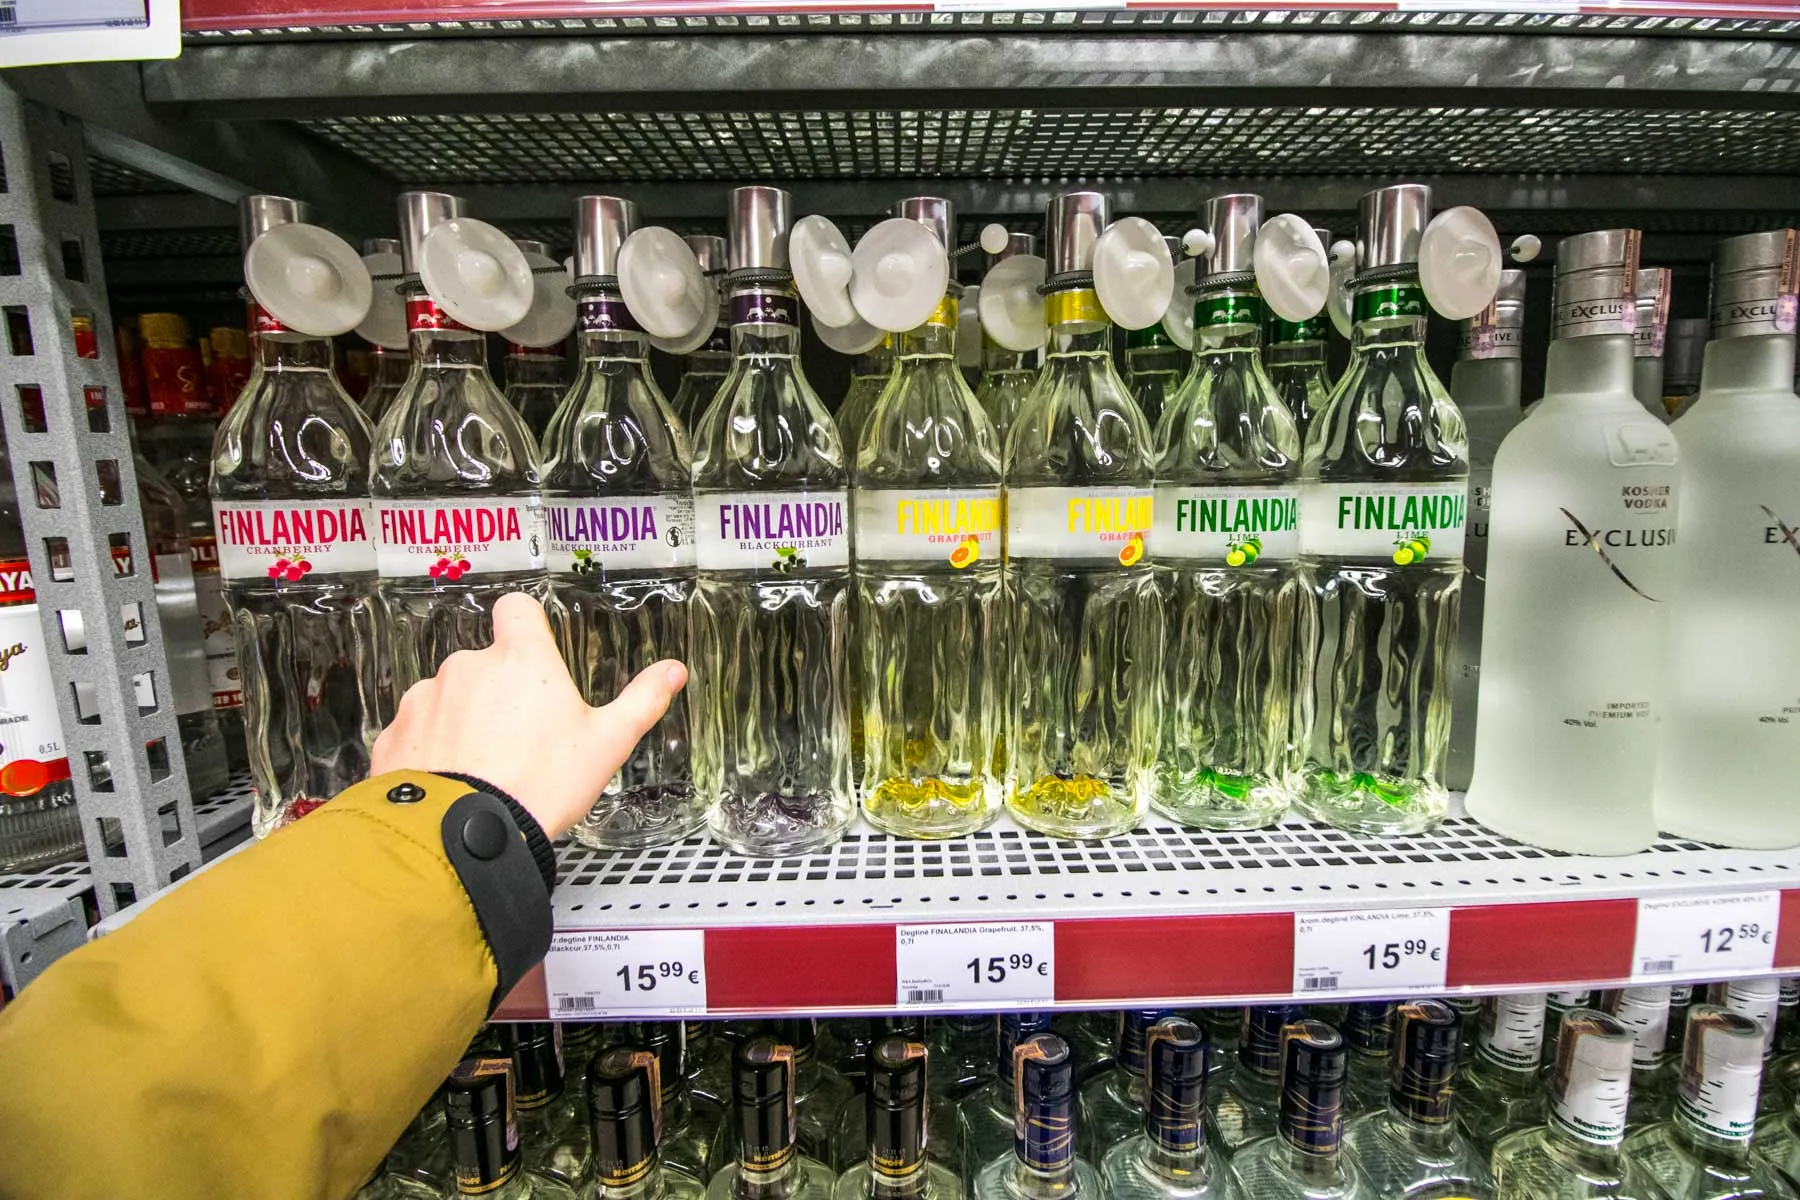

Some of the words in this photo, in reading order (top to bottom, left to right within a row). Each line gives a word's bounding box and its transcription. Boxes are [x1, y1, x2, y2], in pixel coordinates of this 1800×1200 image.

[1622, 486, 1670, 497] KOSHER
[1624, 498, 1667, 509] VODKA
[1177, 498, 1297, 532] FINLANDIA
[1338, 494, 1465, 530] FINLANDIA
[380, 507, 521, 545] FINLANDIA
[720, 502, 843, 540] FINLANDIA
[219, 508, 367, 546] FINLANDIA
[1228, 533, 1259, 541] LIME
[1396, 531, 1429, 539] LIME
[246, 544, 332, 555] CRANBERRY
[408, 543, 490, 554] CRANBERRY
[740, 538, 832, 550] BLACKCURRANT
[931, 927, 977, 936] FINALANDIA
